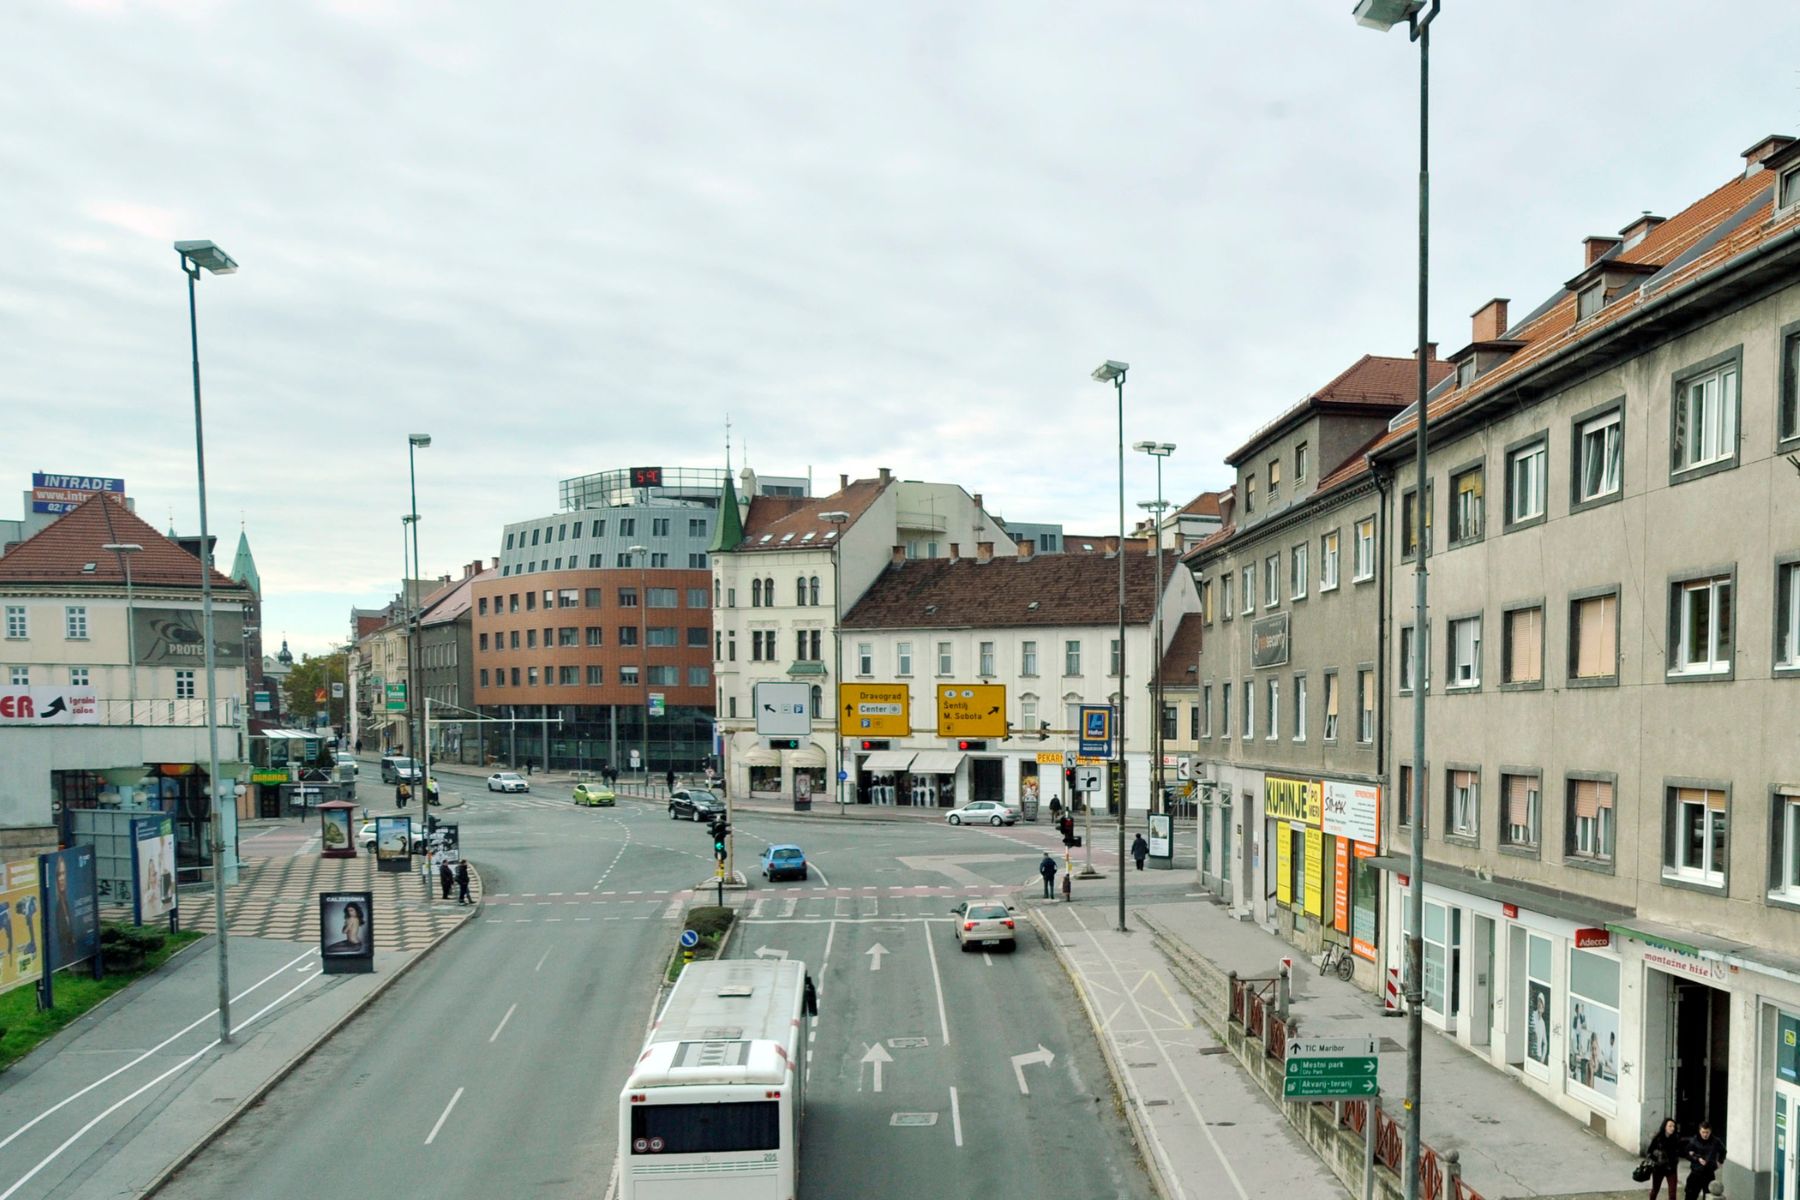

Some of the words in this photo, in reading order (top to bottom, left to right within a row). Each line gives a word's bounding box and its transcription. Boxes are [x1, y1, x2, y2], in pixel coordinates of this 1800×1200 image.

[44, 475, 113, 491] INTRADE
[860, 692, 901, 702] Dravograd
[860, 705, 887, 713] Center
[944, 702, 968, 711] Šentilj
[944, 712, 952, 720] M.
[955, 712, 982, 720] Sobota
[1266, 780, 1307, 819] KUHINJE
[1579, 937, 1608, 947] Adecco
[1329, 1061, 1343, 1069] park
[764, 1153, 777, 1161] 205
